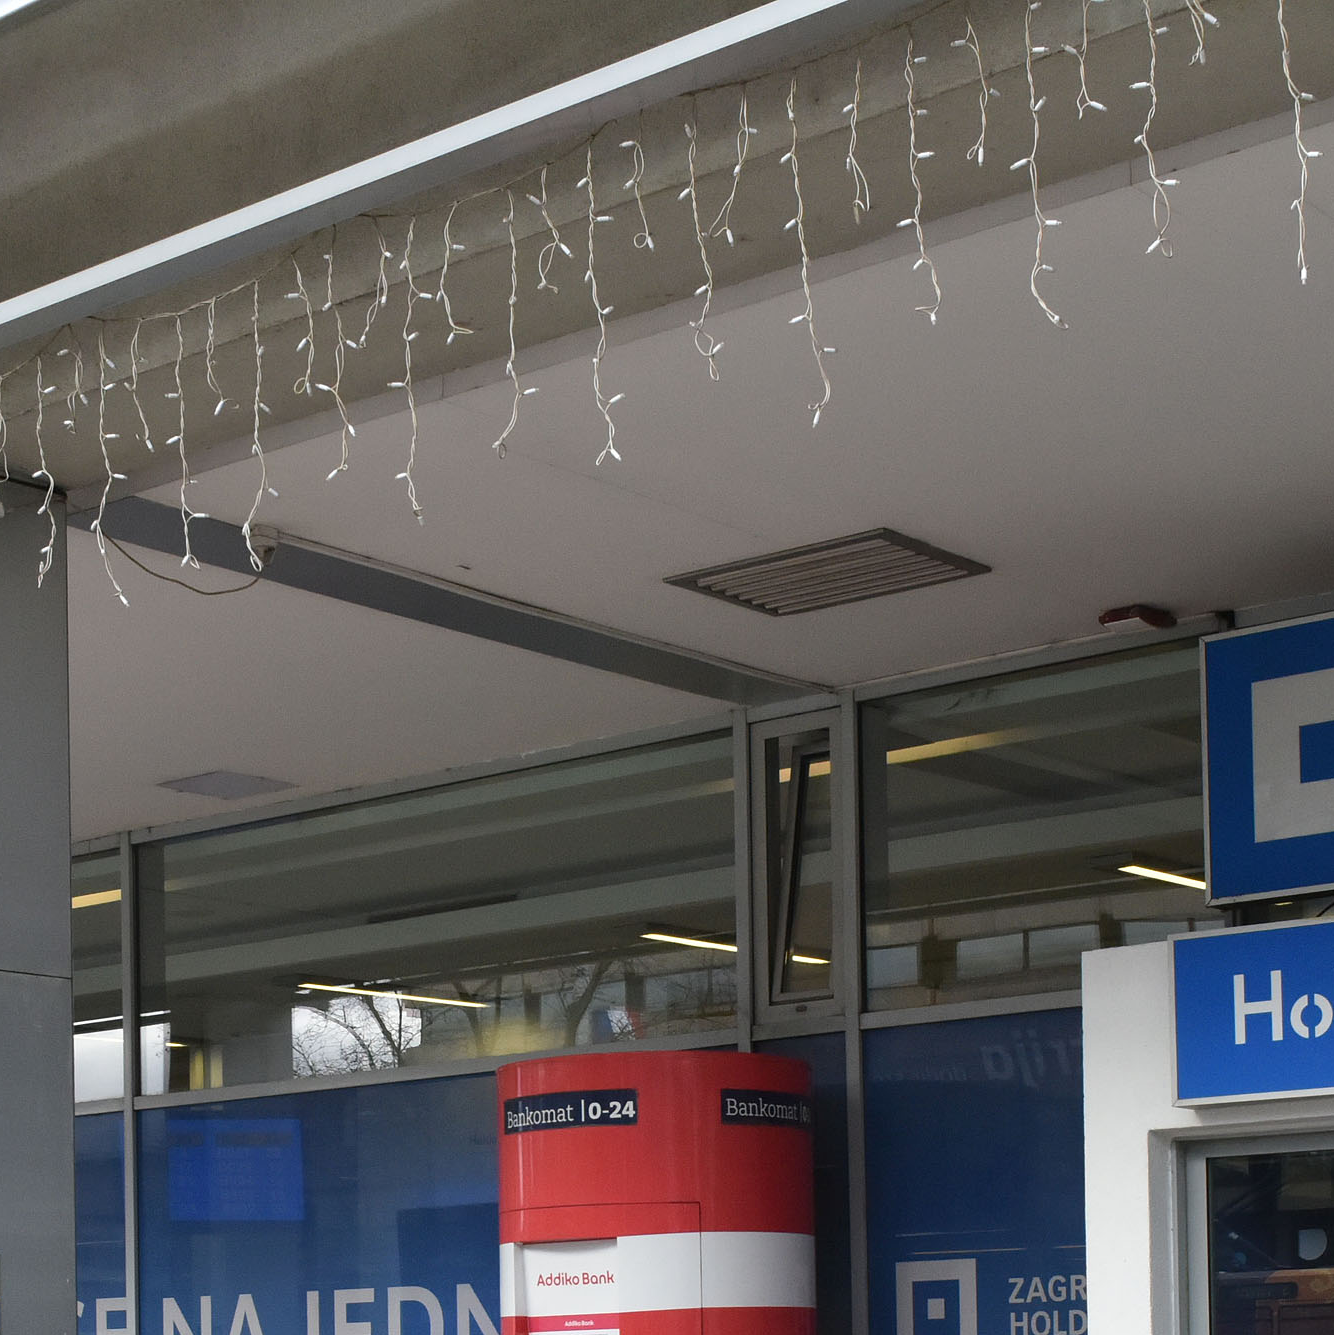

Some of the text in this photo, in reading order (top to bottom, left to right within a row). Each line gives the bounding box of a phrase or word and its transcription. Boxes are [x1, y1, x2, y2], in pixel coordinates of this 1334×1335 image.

[507, 1100, 636, 1130] Bankomat 0-24
[726, 1098, 798, 1120] Bankomat
[537, 1270, 614, 1286] Addiko Bank
[1008, 1276, 1087, 1306] ZAGR
